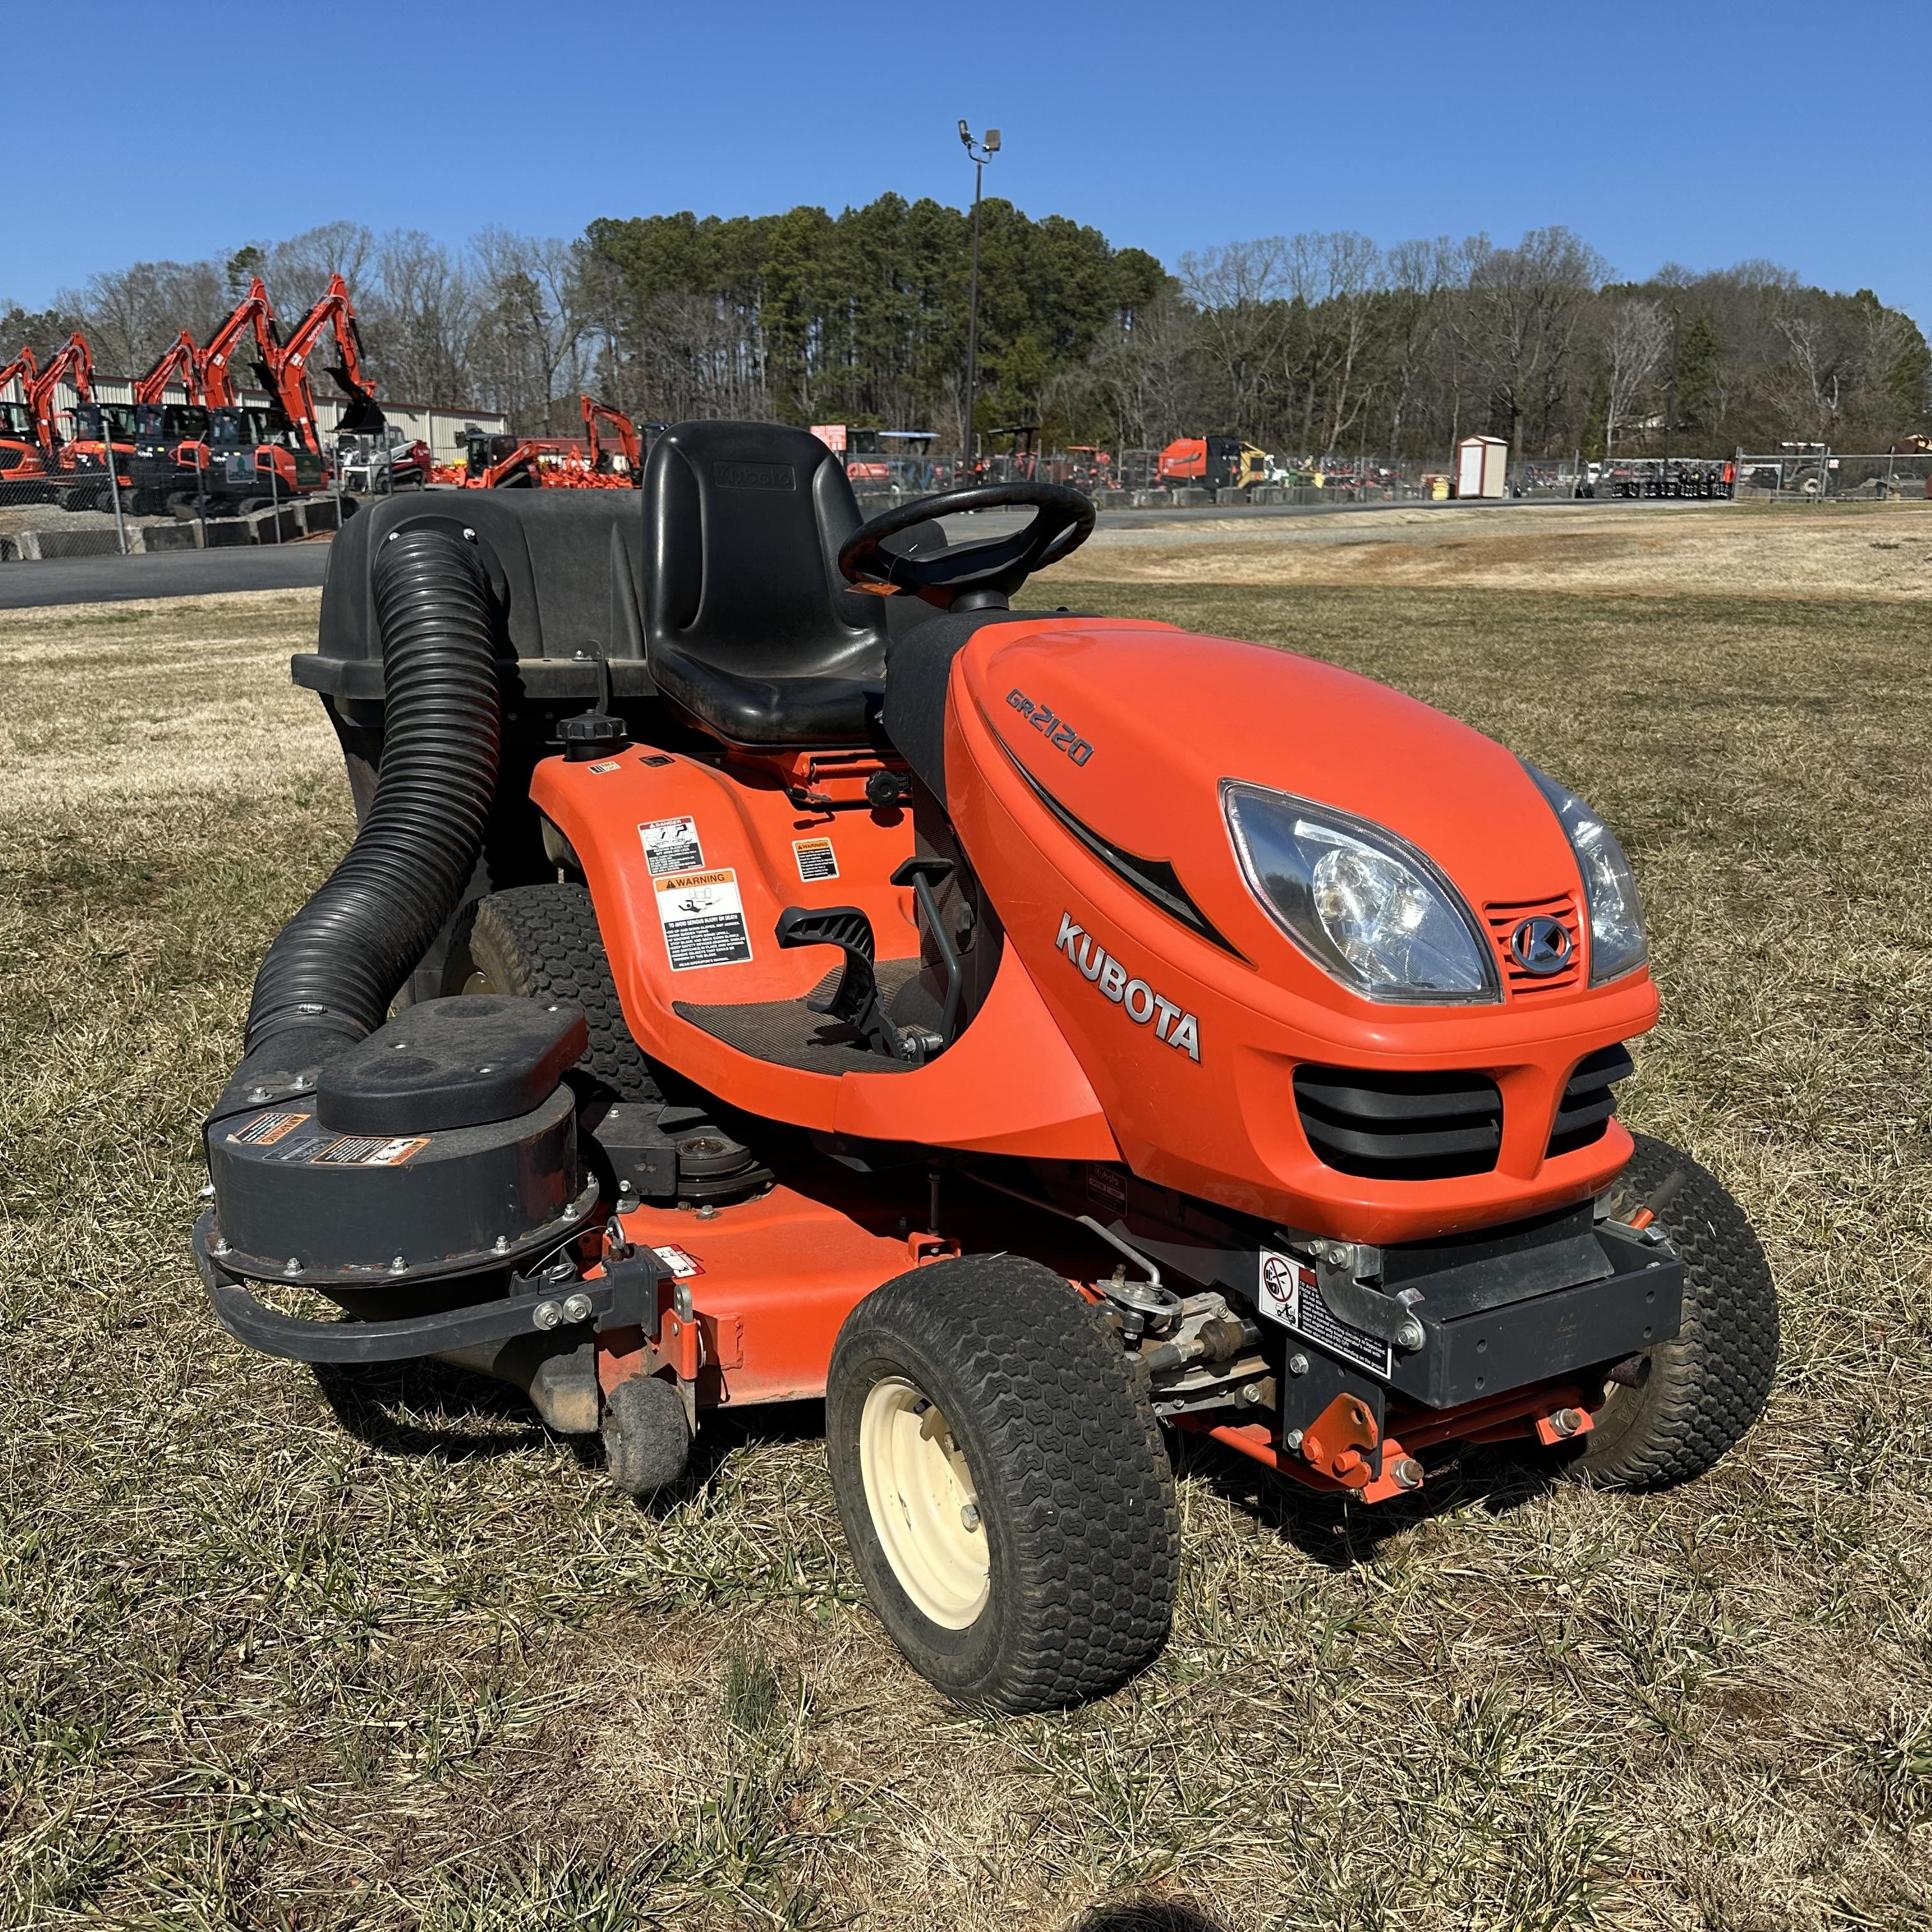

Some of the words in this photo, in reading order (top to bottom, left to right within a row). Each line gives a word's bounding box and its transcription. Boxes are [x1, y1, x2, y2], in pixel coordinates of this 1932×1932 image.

[1006, 689, 1094, 767] GR2120
[676, 874, 725, 887] WARNING
[1055, 911, 1202, 1065] KUBOTA
